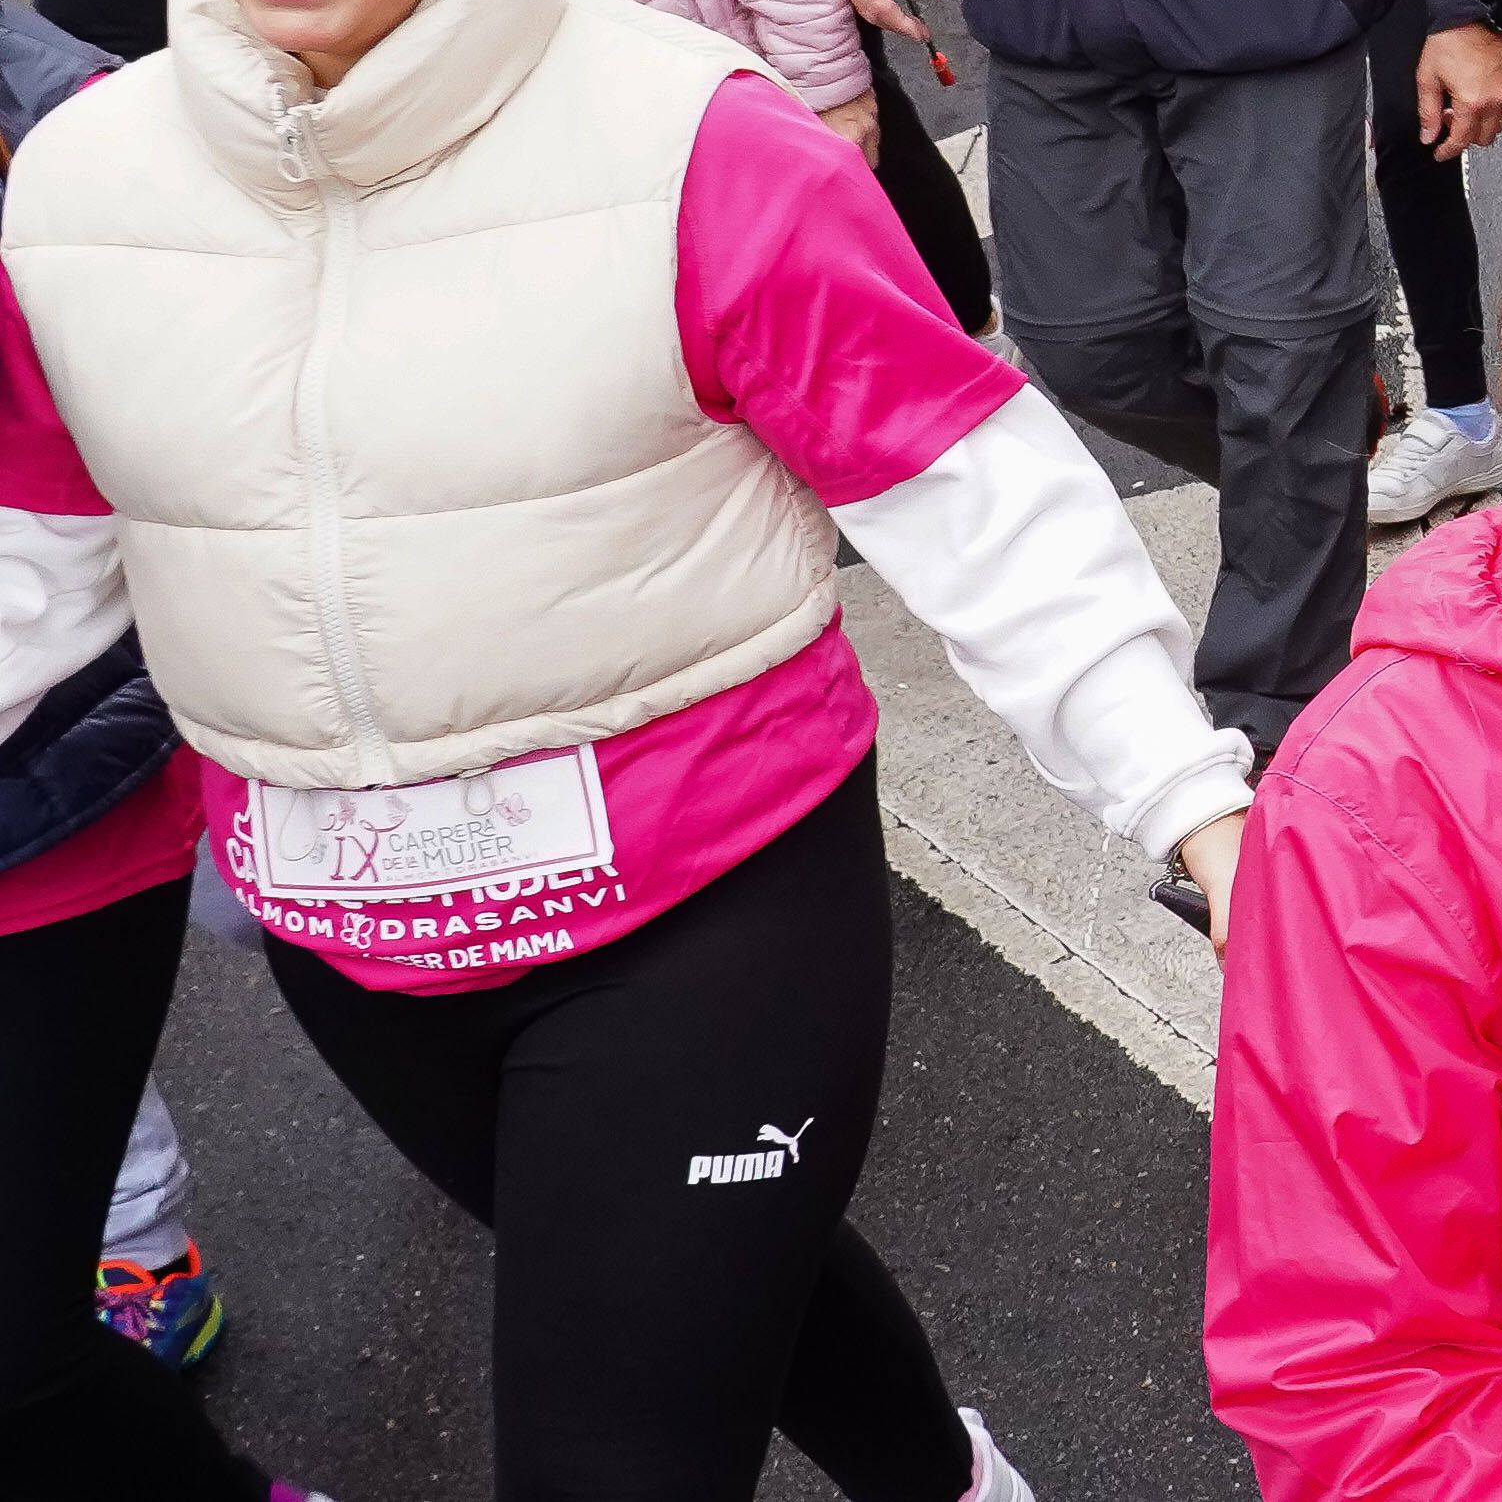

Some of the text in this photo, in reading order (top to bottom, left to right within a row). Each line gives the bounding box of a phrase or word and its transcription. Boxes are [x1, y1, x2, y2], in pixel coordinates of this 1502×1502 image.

[388, 818, 497, 853] CARRERA
[422, 835, 514, 870] MUJER
[379, 884, 627, 941] DRASANVI
[447, 948, 486, 970] DE
[490, 929, 575, 967] MAMA
[687, 1150, 785, 1185] PUMA
